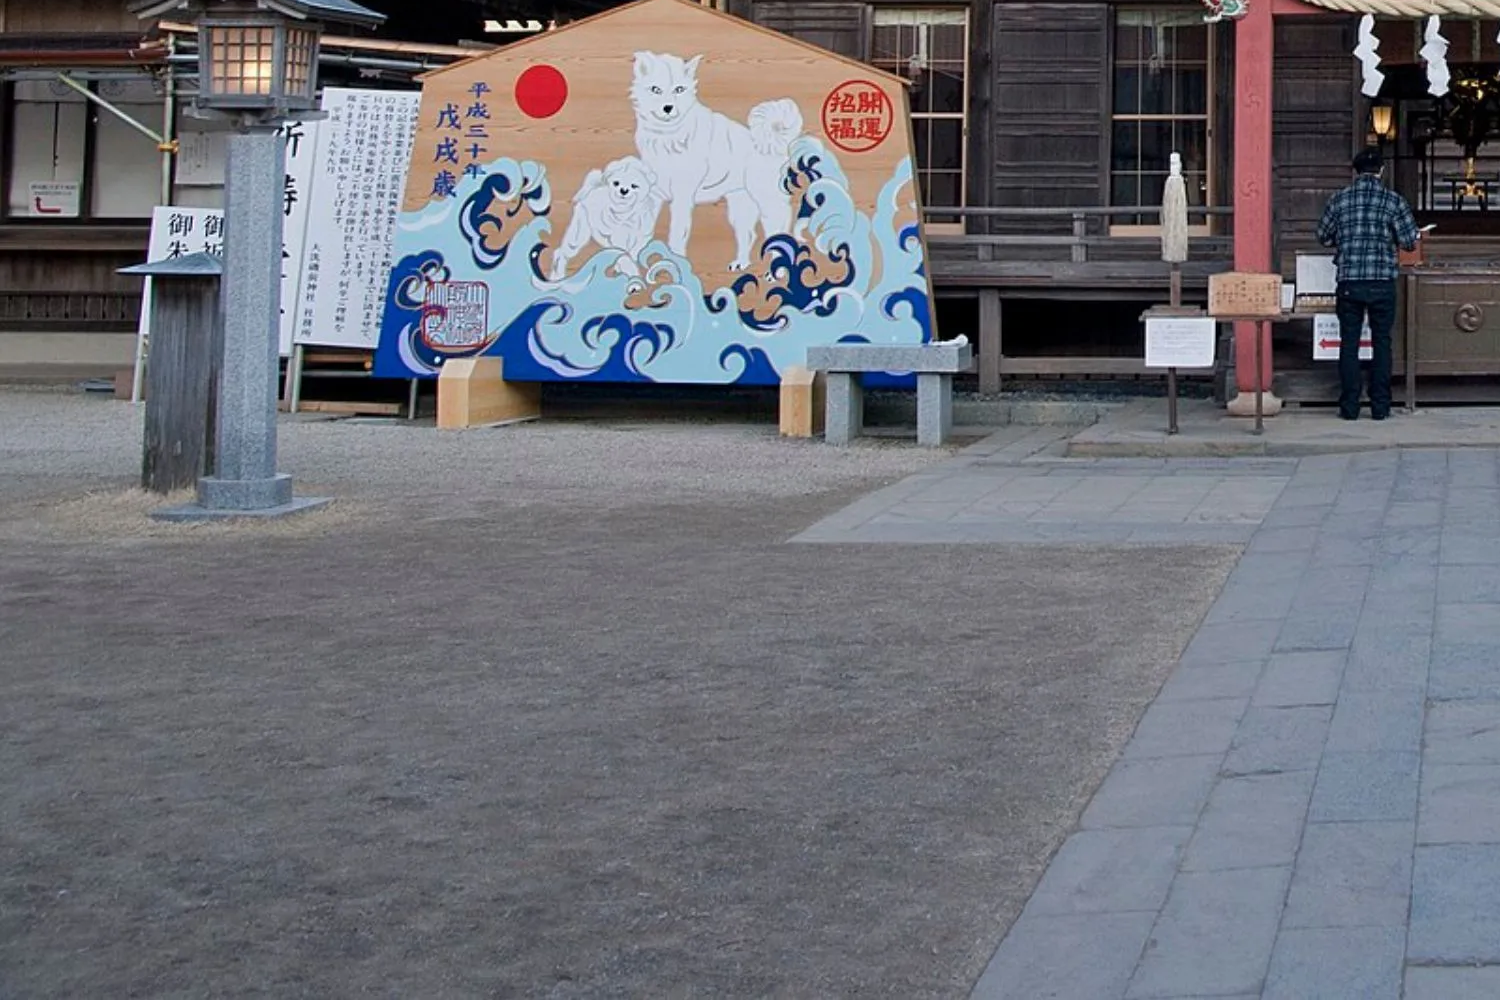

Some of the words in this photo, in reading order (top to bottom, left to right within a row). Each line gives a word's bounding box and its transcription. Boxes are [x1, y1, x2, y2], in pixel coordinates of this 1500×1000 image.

[430, 103, 461, 197] 戊戌歳
[462, 82, 491, 180] 平成三十年
[830, 93, 856, 139] 招福
[857, 91, 883, 142] 開運
